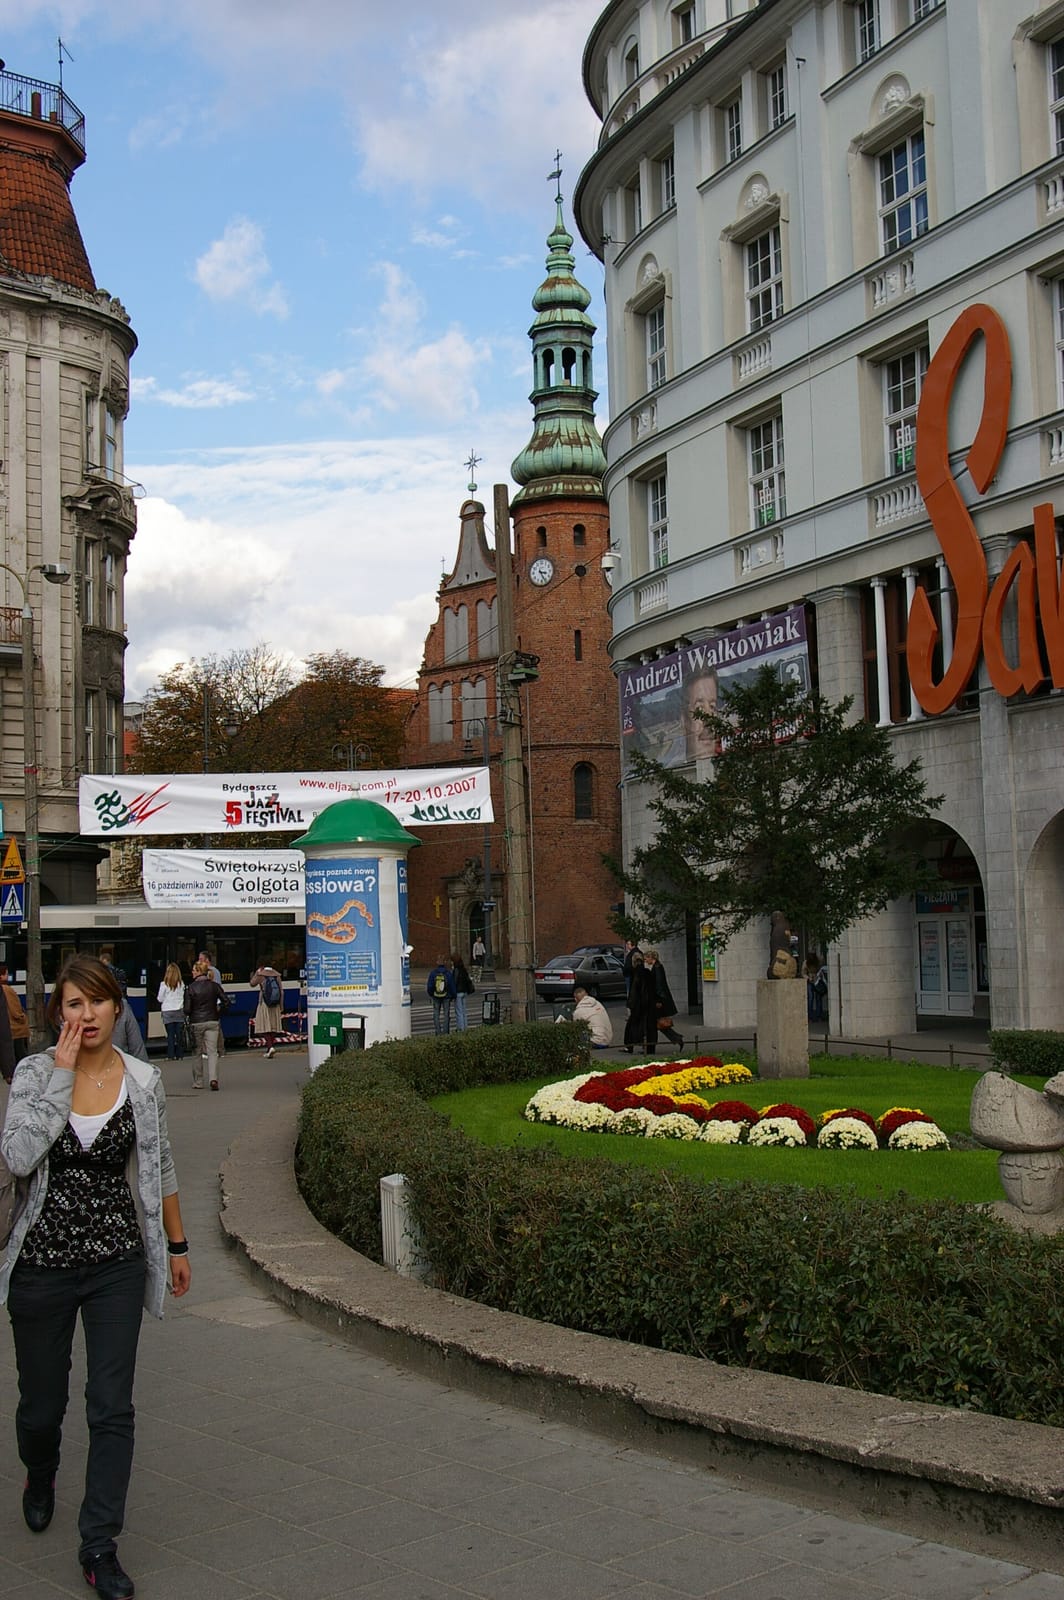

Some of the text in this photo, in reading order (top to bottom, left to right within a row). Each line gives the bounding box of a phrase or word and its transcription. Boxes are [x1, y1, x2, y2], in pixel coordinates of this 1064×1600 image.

[623, 615, 801, 698] Andrzej Walkowiak
[222, 783, 278, 794] Bydgoszcz
[299, 777, 397, 792] www.eljaz.com.pl
[384, 777, 478, 804] 17-20.10.2007
[224, 801, 243, 826] 5
[246, 806, 305, 828] FESTIVAL
[204, 857, 306, 875] Świętokrzysk
[326, 868, 353, 877] poznać
[147, 881, 156, 890] 16
[206, 880, 223, 890] 2007
[232, 876, 299, 895] Golgota
[248, 896, 290, 905] Bydgoszczy
